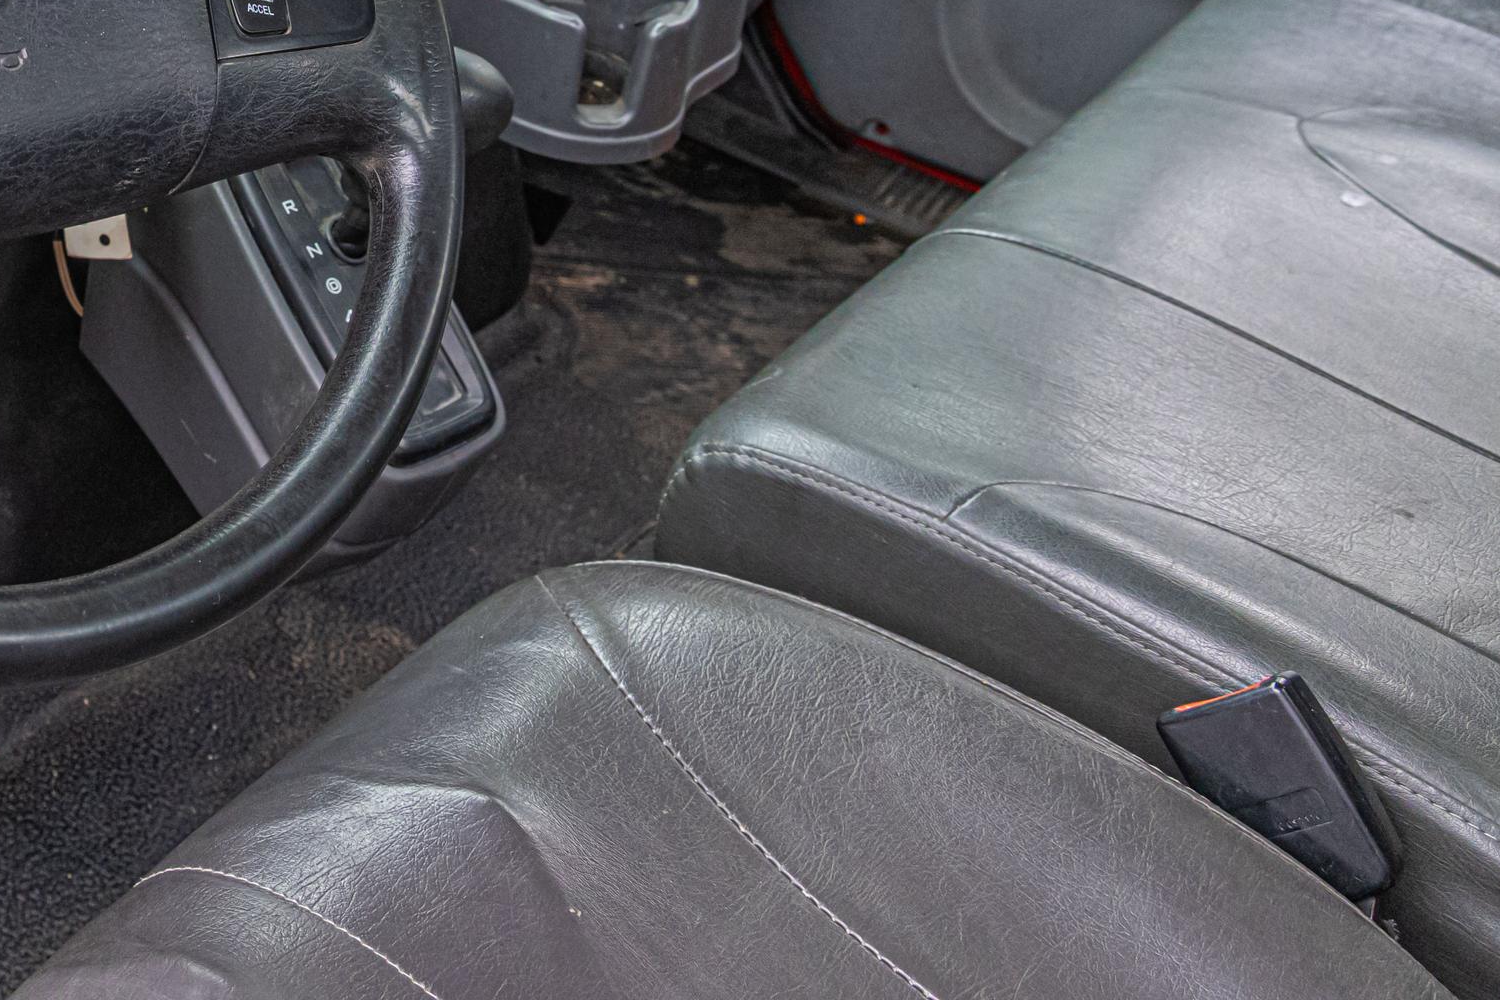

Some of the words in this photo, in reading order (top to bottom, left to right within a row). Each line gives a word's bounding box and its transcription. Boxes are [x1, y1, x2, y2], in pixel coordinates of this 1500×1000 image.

[247, 3, 275, 16] ACCEL
[281, 199, 299, 215] R
[305, 242, 323, 258] N
